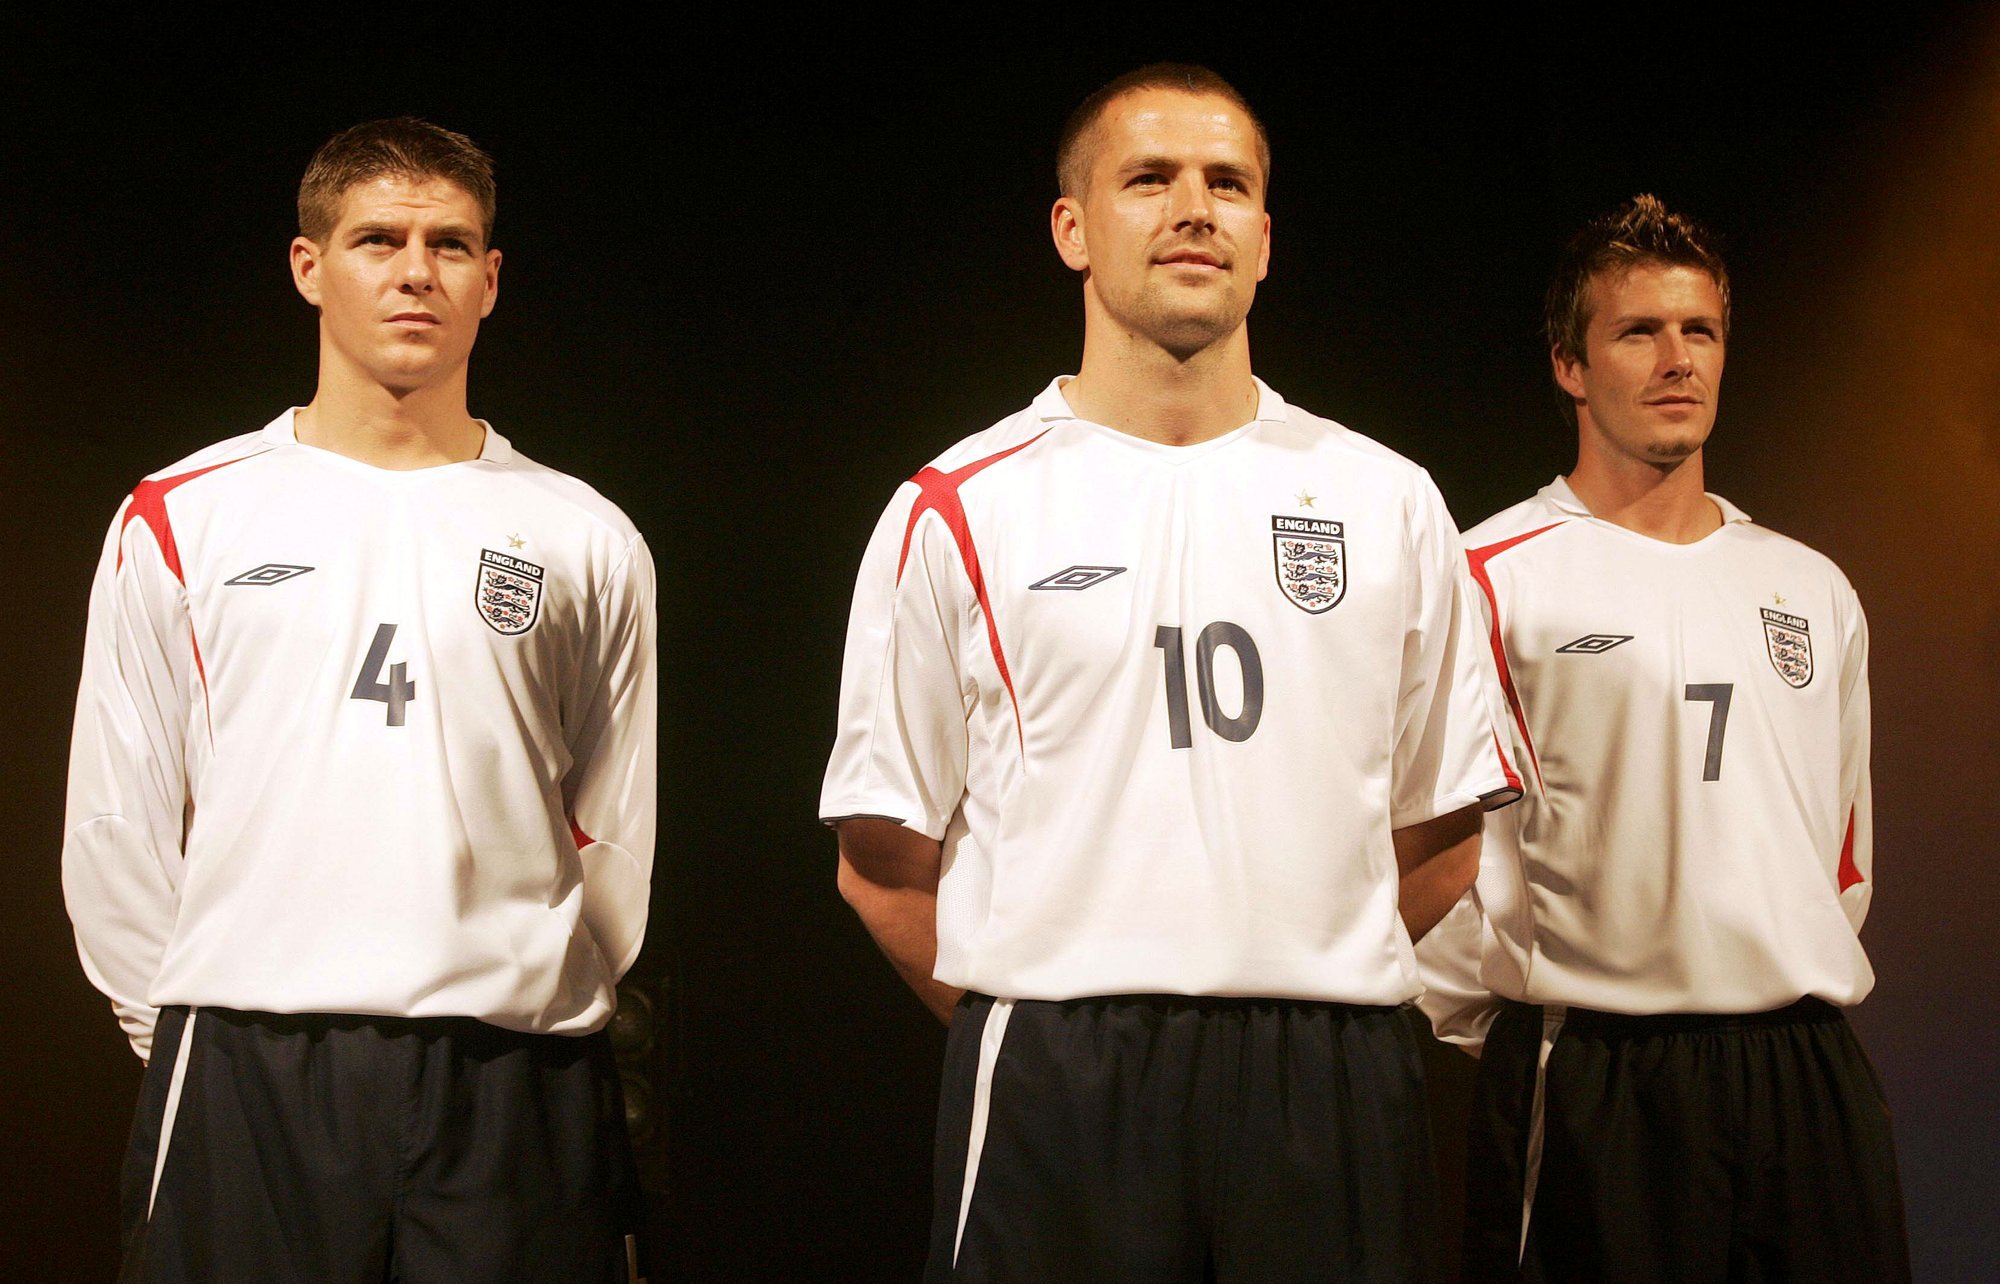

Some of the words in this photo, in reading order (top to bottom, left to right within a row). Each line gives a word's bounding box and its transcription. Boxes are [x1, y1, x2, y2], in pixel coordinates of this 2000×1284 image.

[1276, 518, 1341, 535] ENGLAND
[484, 551, 541, 576] ENGLAND
[1763, 609, 1807, 629] ENGLAND
[350, 623, 415, 727] 4
[1154, 621, 1264, 750] 10
[1685, 683, 1734, 782] 7
